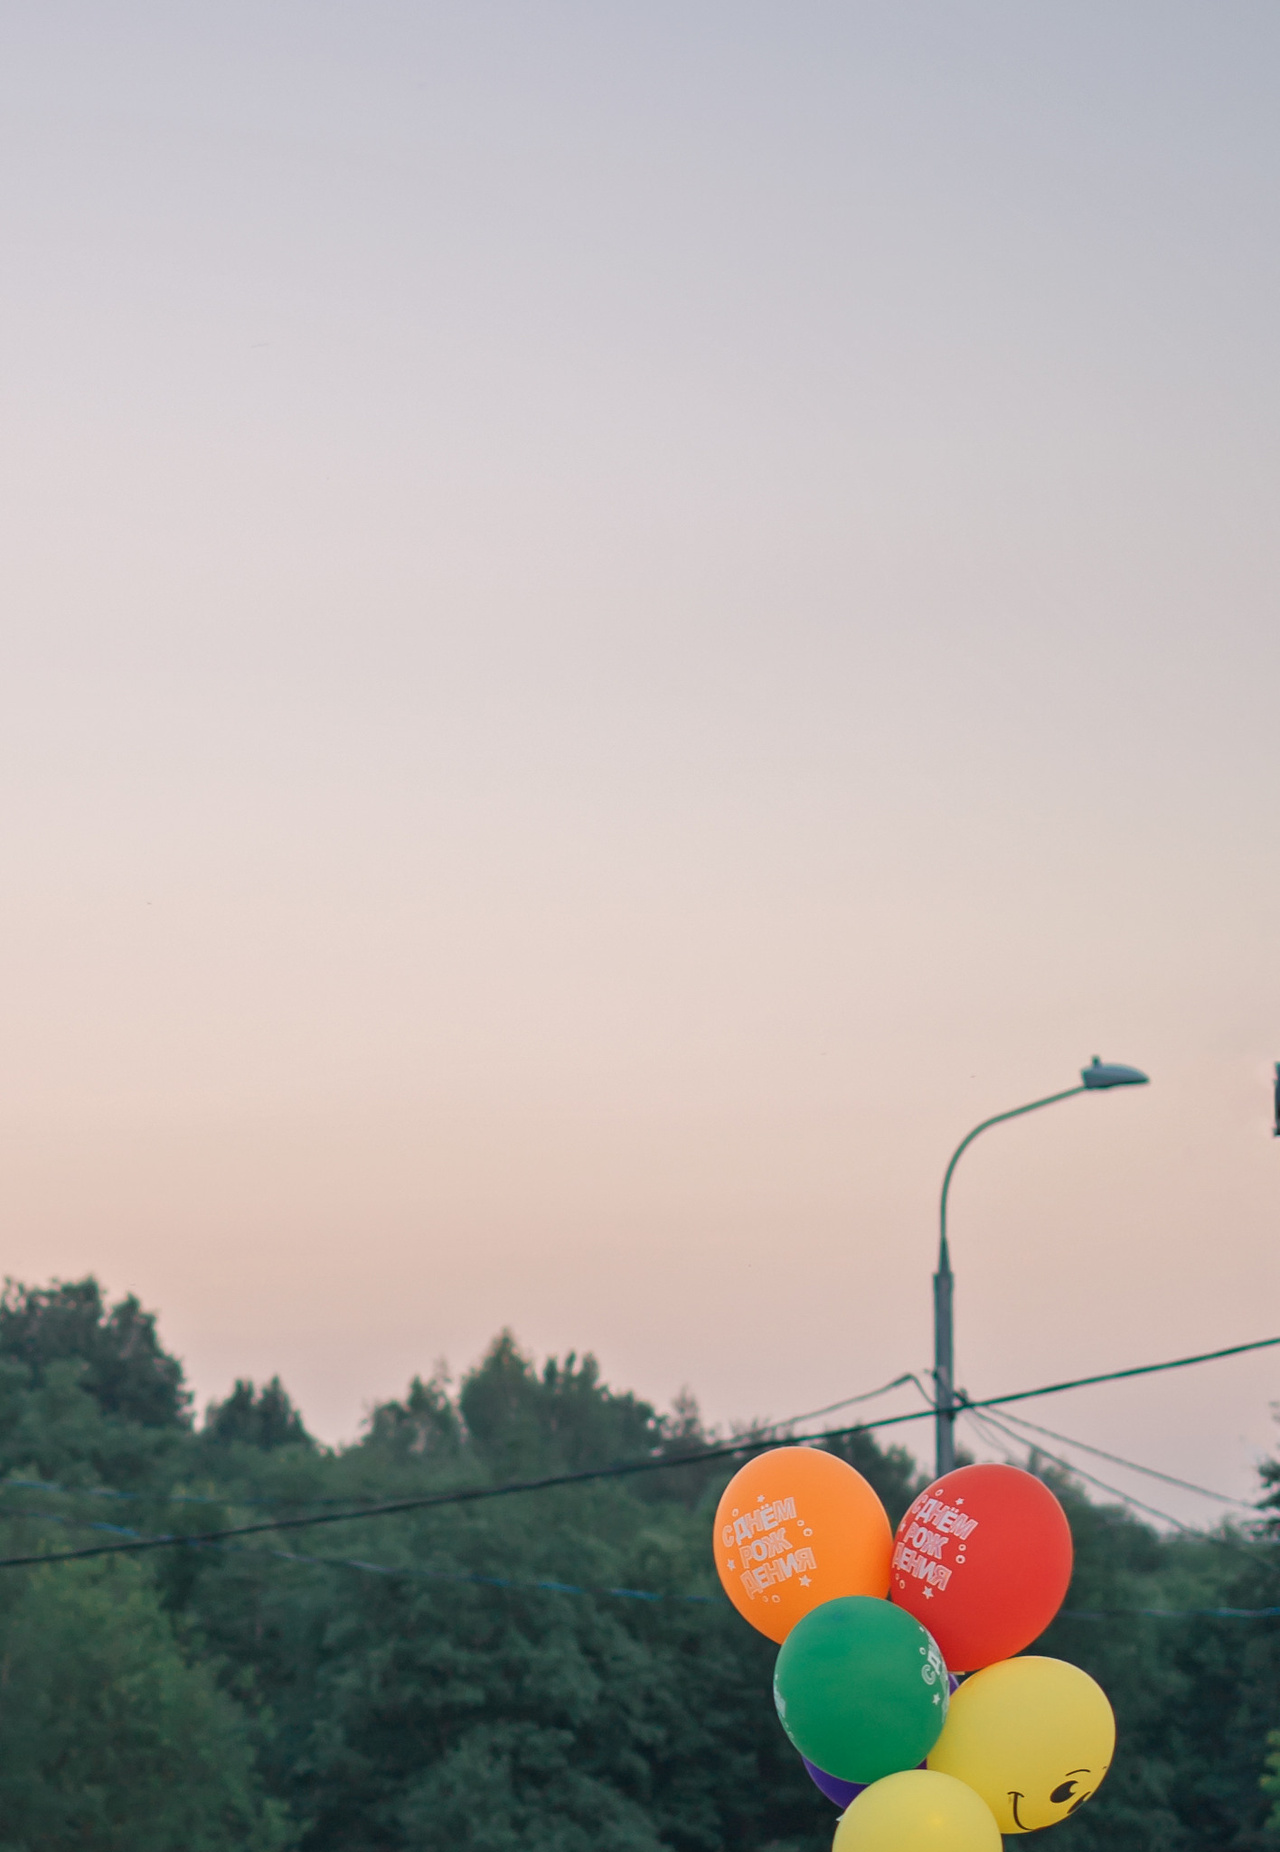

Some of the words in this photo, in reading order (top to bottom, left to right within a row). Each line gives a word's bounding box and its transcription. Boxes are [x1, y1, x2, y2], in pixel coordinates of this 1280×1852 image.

[739, 1527, 793, 1569] РОЖ
[903, 1521, 949, 1560] РОЖ
[740, 1547, 817, 1600] ДЕНИЯ
[892, 1541, 953, 1591] ДЕНИЯ
